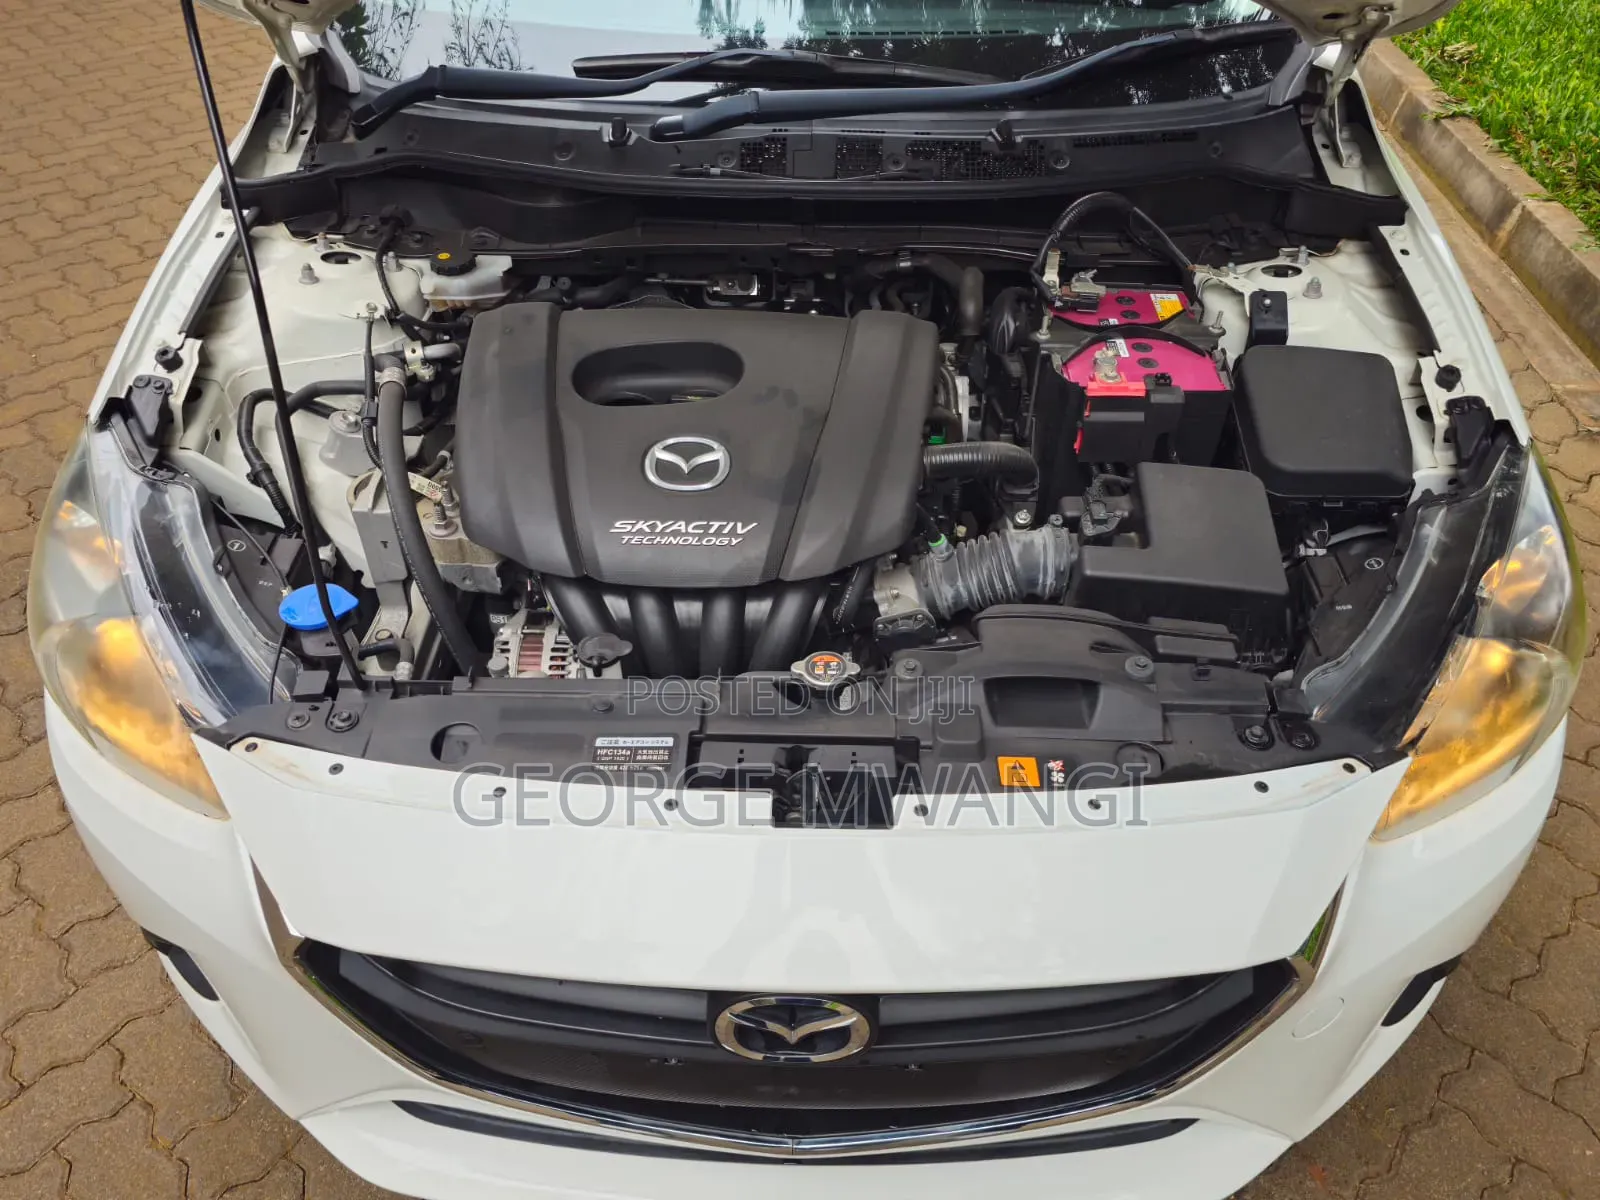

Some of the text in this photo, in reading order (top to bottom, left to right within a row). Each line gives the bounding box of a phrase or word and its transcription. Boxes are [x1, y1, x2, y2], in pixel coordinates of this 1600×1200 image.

[609, 520, 758, 535] SKYACTIV
[621, 536, 743, 547] TECHNOLOGY
[597, 748, 631, 756] HFC134a
